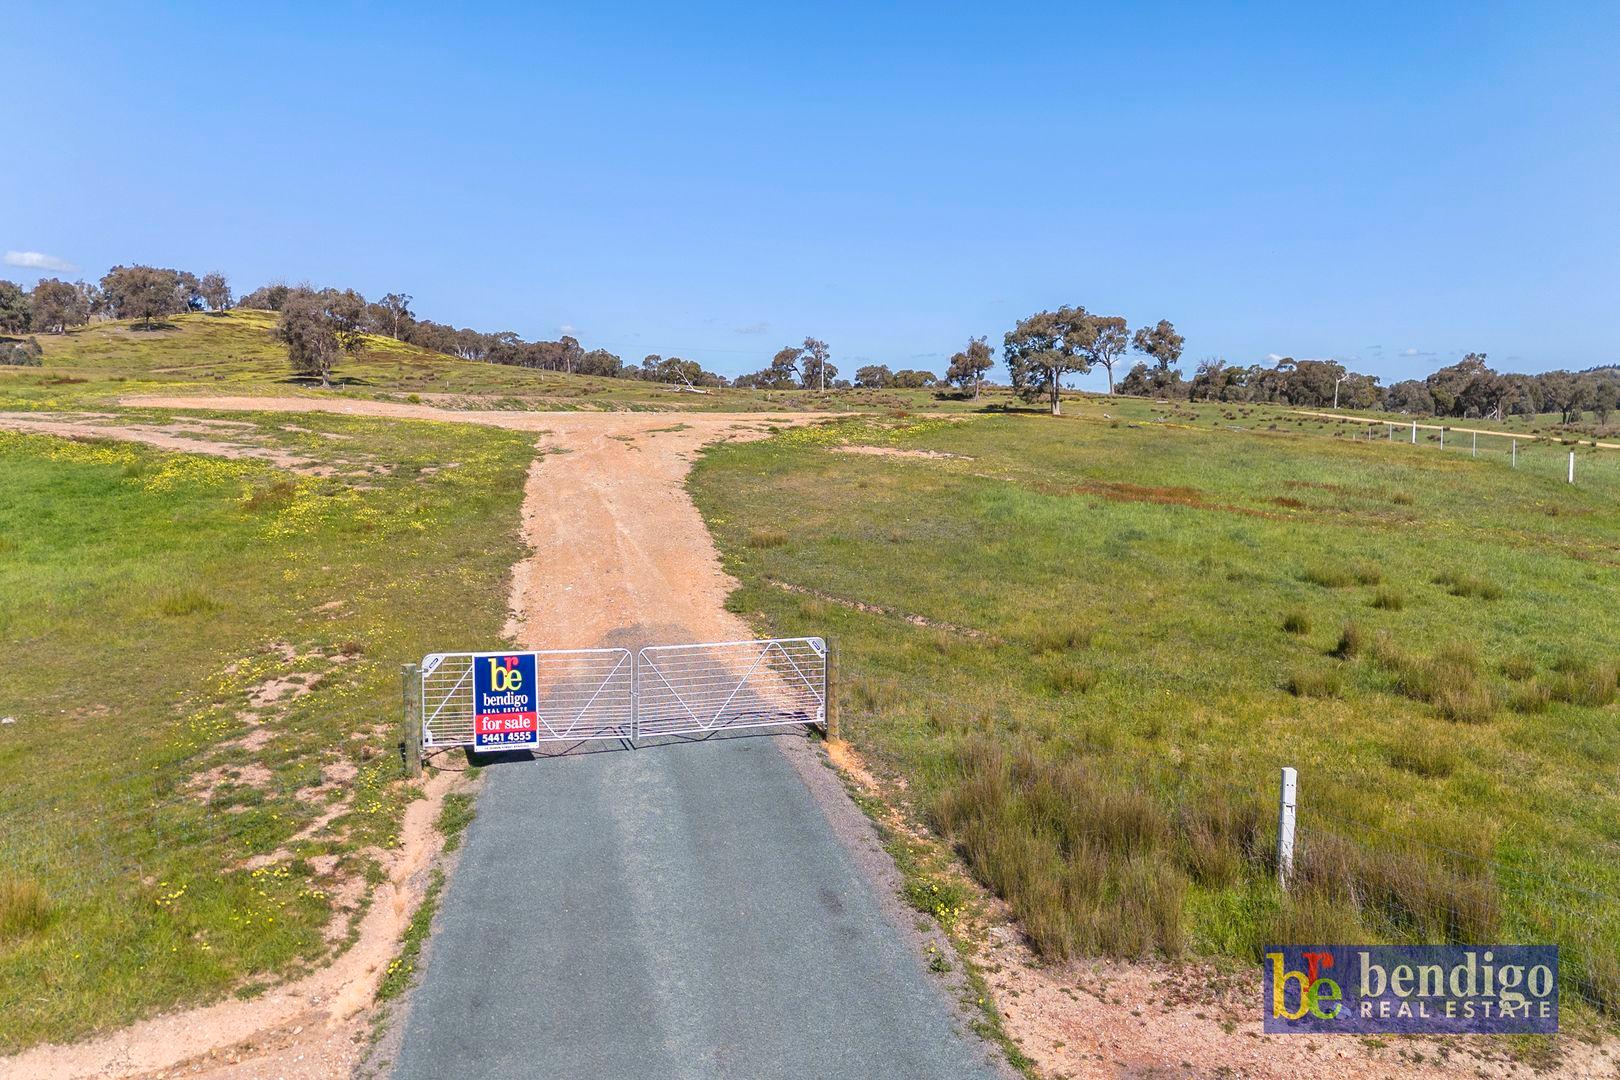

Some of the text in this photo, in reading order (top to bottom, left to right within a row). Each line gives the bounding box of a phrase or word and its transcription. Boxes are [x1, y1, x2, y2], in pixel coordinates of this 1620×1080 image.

[483, 691, 528, 707] bendigo
[482, 714, 531, 731] for sale
[482, 733, 504, 743] 5441
[508, 731, 531, 741] 4555
